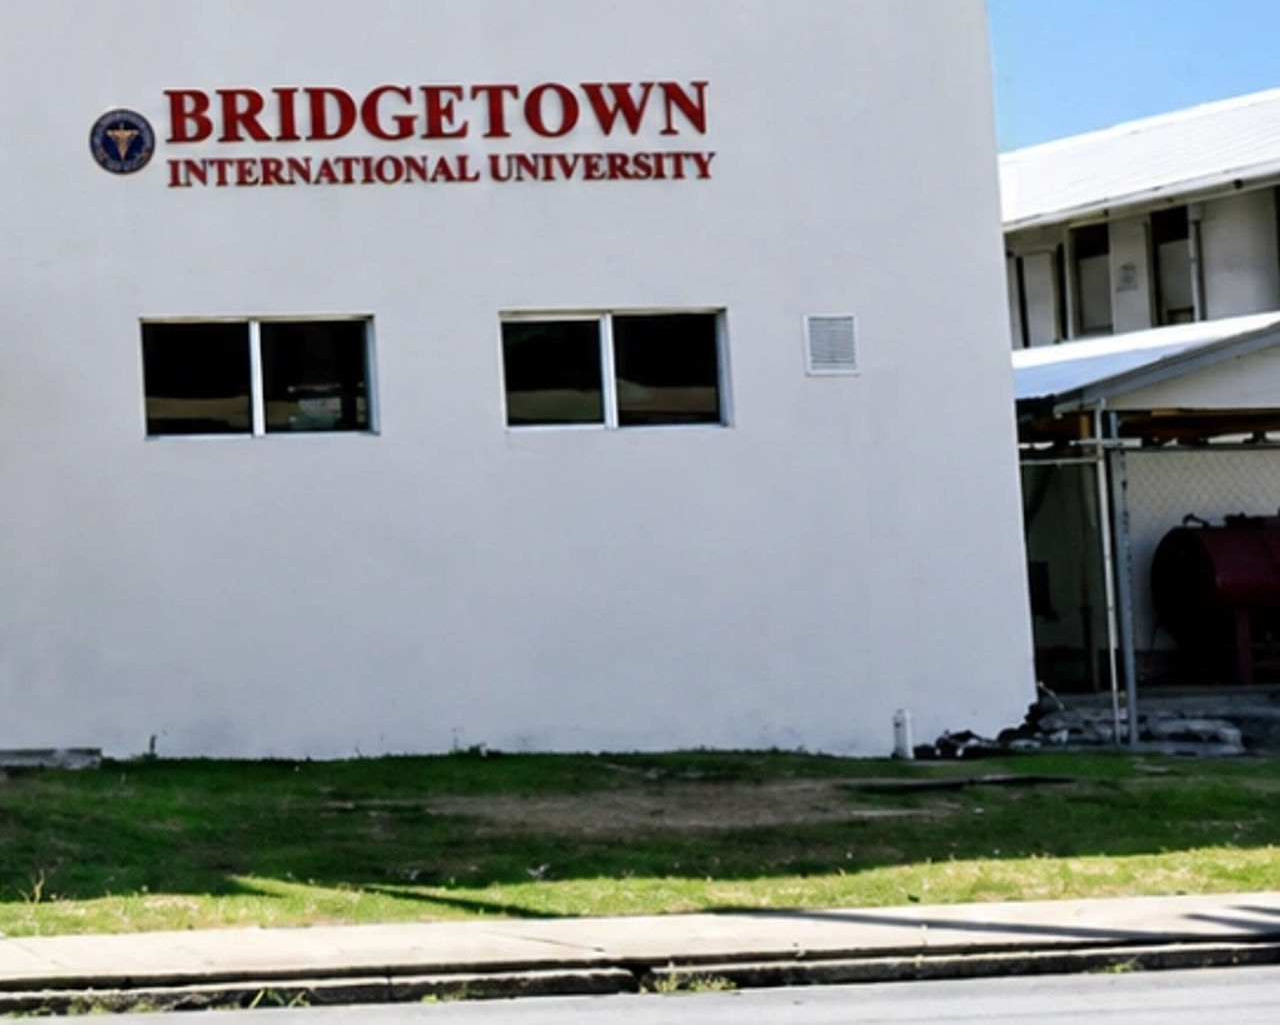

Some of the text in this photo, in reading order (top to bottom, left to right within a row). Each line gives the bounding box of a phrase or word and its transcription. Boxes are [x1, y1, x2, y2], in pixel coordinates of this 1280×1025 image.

[163, 81, 710, 143] BRIDGETOWN
[167, 151, 716, 188] INTERNATIONAL UNIVERSITY
